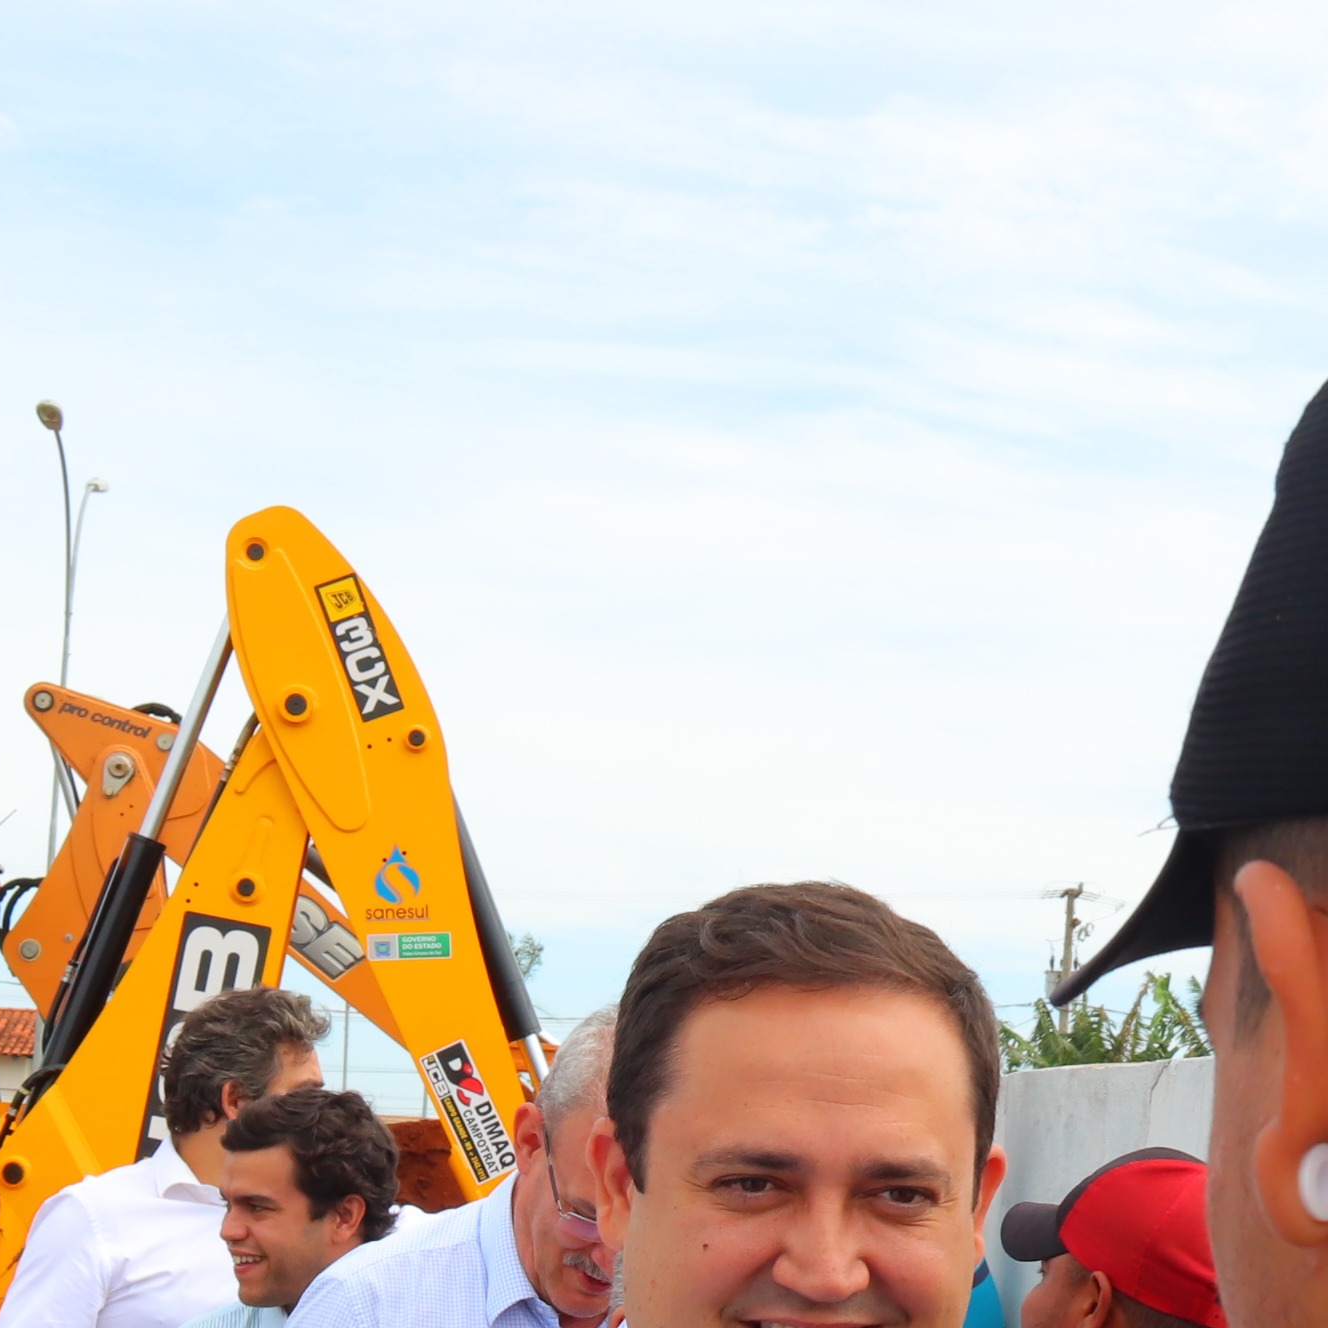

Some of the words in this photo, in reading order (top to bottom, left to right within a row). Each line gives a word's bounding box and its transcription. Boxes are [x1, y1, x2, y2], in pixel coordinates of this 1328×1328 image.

[331, 591, 354, 609] JCB
[335, 616, 400, 715] 3CX
[58, 703, 89, 718] pro
[91, 713, 152, 738] control
[365, 904, 429, 920] sanesul
[423, 1056, 449, 1098] JCB
[443, 1097, 458, 1117] CAMPO
[453, 1116, 468, 1140] GRANDE
[475, 1100, 516, 1170] DIMAQ
[462, 1109, 500, 1175] CAMPOTRAT
